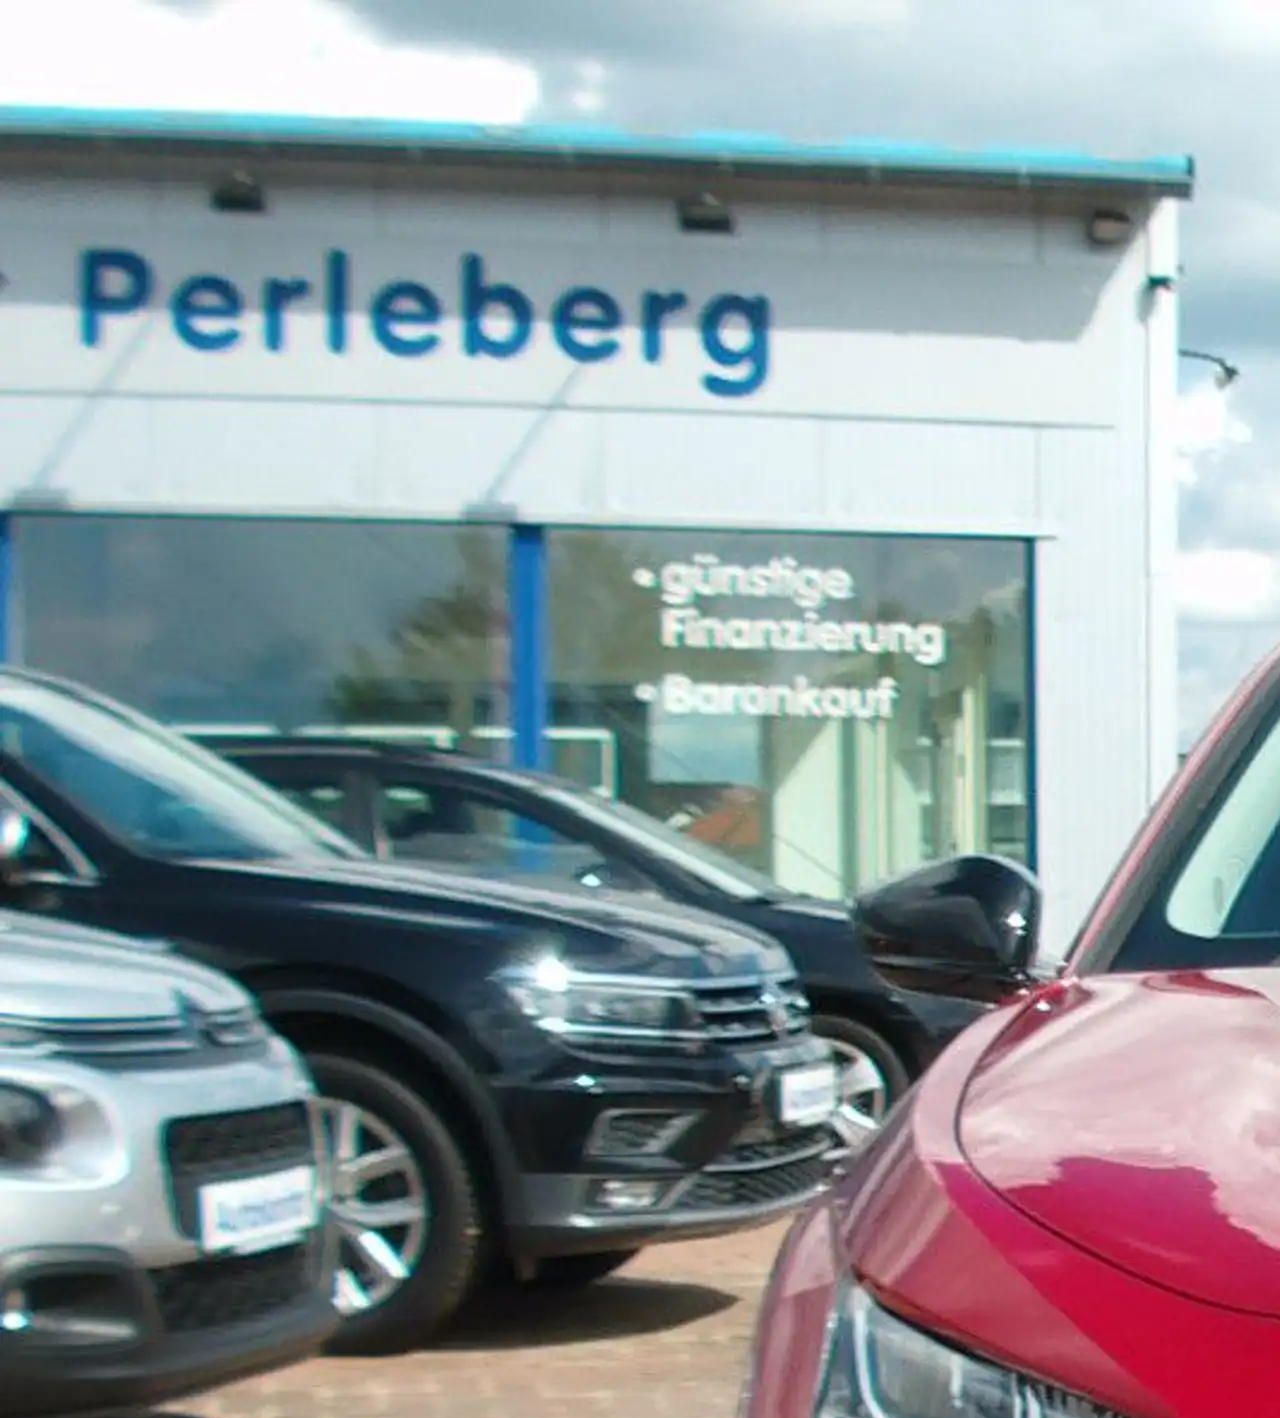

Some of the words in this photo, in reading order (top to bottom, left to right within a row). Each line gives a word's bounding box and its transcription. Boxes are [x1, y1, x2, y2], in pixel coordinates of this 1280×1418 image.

[79, 247, 772, 398] Perleberg
[660, 553, 854, 607] günstige
[660, 608, 946, 664] Finanzierung
[661, 673, 897, 719] Barankauf
